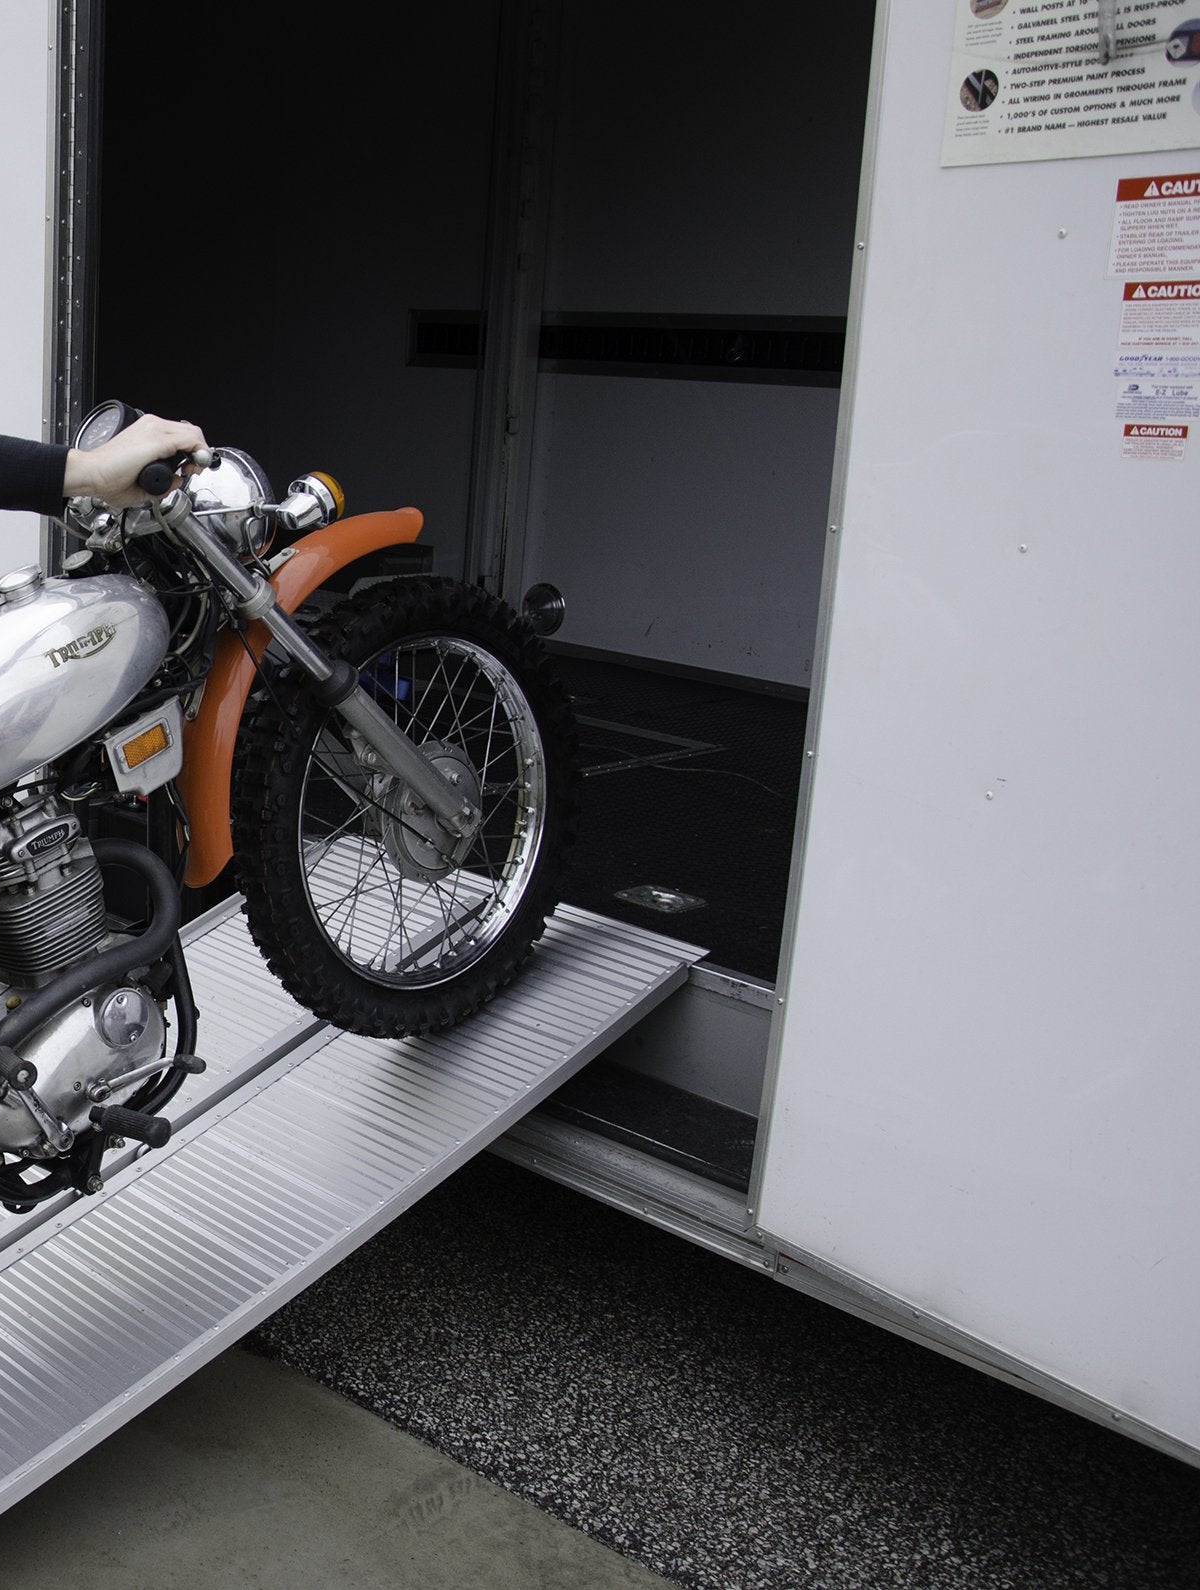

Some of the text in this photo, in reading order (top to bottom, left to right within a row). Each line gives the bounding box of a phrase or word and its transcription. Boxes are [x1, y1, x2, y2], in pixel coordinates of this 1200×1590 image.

[1019, 6, 1038, 14] WALL
[1040, 2, 1064, 10] POSTS
[1015, 36, 1034, 45] STEEL
[1036, 30, 1072, 42] FRAMING
[1128, 18, 1156, 29] DOORS
[1018, 18, 1057, 30] GALVANEEL
[1060, 14, 1080, 23] STEEL
[1014, 47, 1062, 60] INDEPENDENT
[1065, 42, 1099, 53] TORSION
[1011, 60, 1083, 75] AUTOMOTIVE-STYLE
[1010, 67, 1145, 90] TWO-STEP PREMIUM PAINT PROCESS
[1022, 94, 1050, 103] WIRING
[1116, 82, 1156, 93] THROUGH
[1158, 78, 1187, 88] FRAME
[1007, 110, 1036, 120] 1,000'S
[1050, 106, 1080, 115] CUSTOM
[1083, 102, 1116, 112] OPTIONS
[1129, 98, 1153, 107] MUCH
[1156, 94, 1181, 104] MORE
[1017, 124, 1042, 133] BRAND
[1044, 122, 1066, 131] NAME
[1076, 118, 1109, 128] HIGHEST
[1111, 115, 1139, 125] RESALE
[1142, 112, 1167, 121] VALUE
[1140, 427, 1182, 436] CAUTION
[45, 621, 117, 668] TRIUMPH
[31, 828, 66, 850] TRIUMPH
